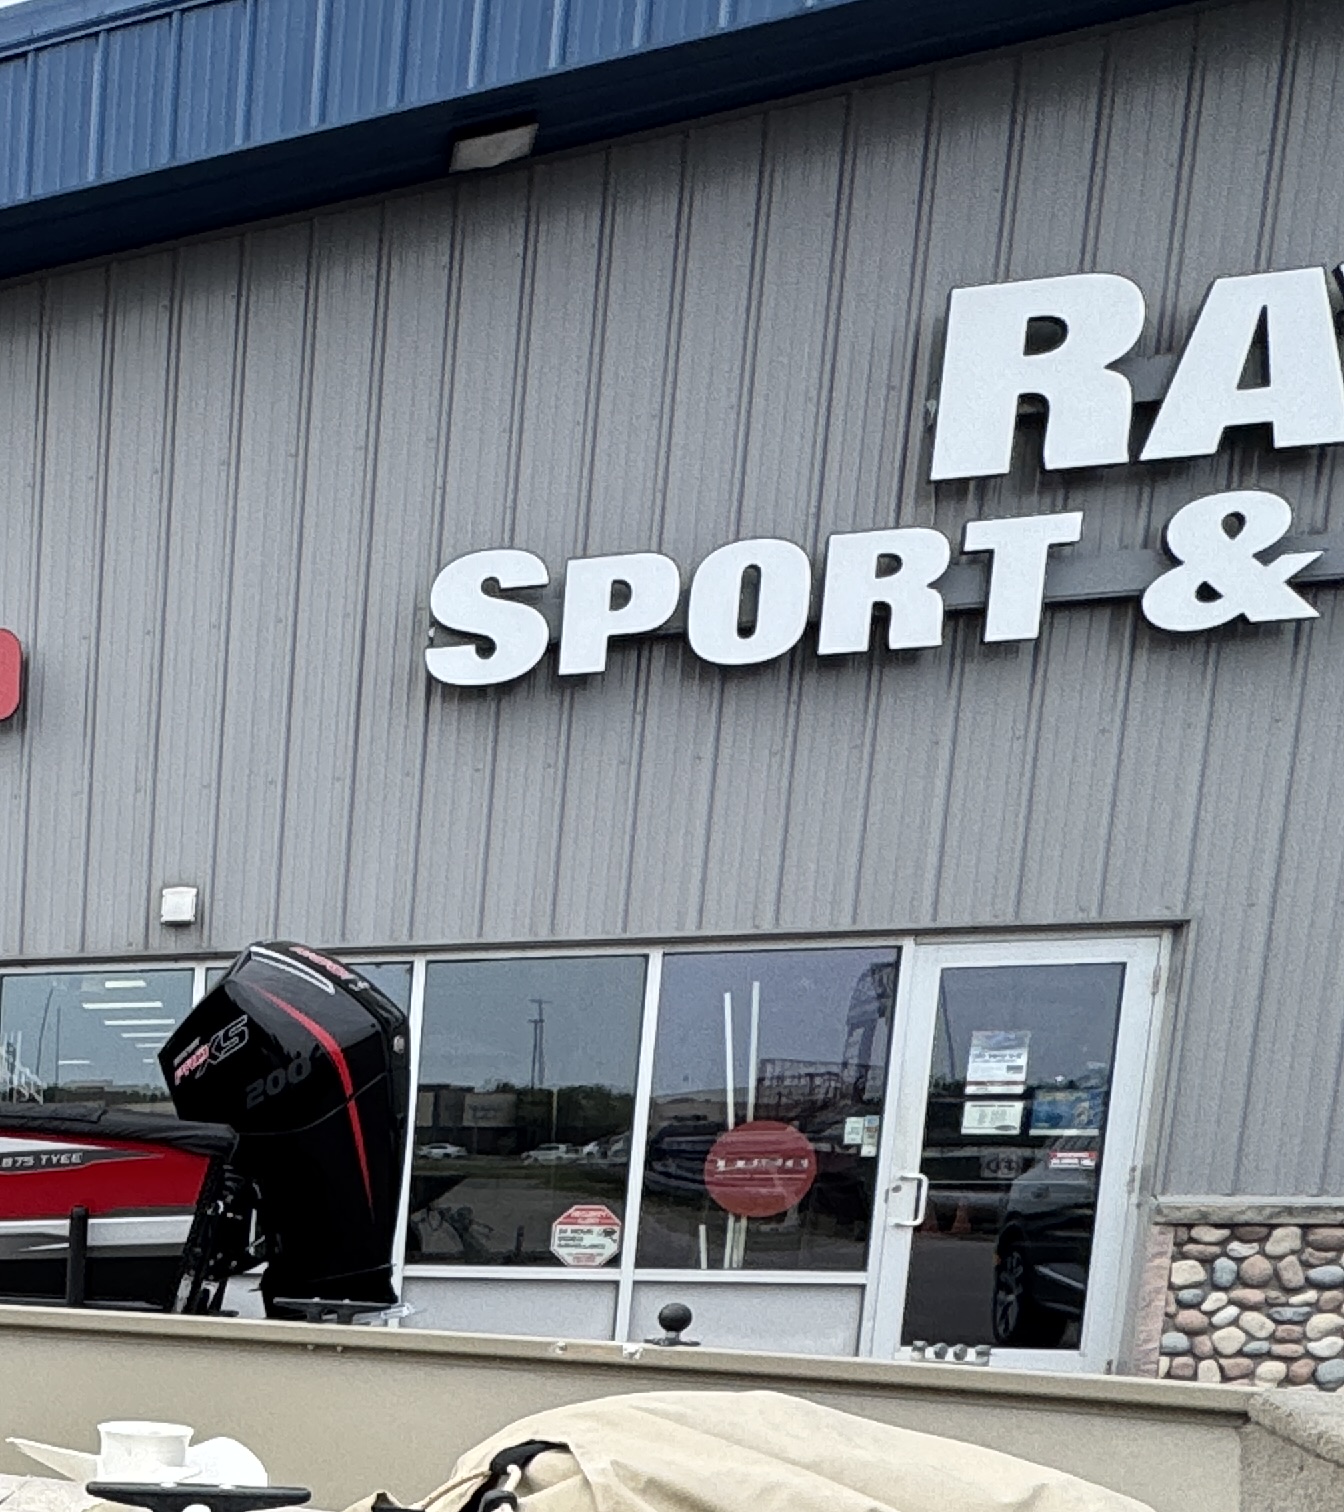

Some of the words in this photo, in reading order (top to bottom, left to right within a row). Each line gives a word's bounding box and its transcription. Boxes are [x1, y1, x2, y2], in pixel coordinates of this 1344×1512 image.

[930, 264, 1344, 482] RA
[424, 510, 1083, 687] SPORT
[1141, 488, 1324, 632] &
[245, 1054, 312, 1110] 200
[40, 1152, 83, 1166] TYEE
